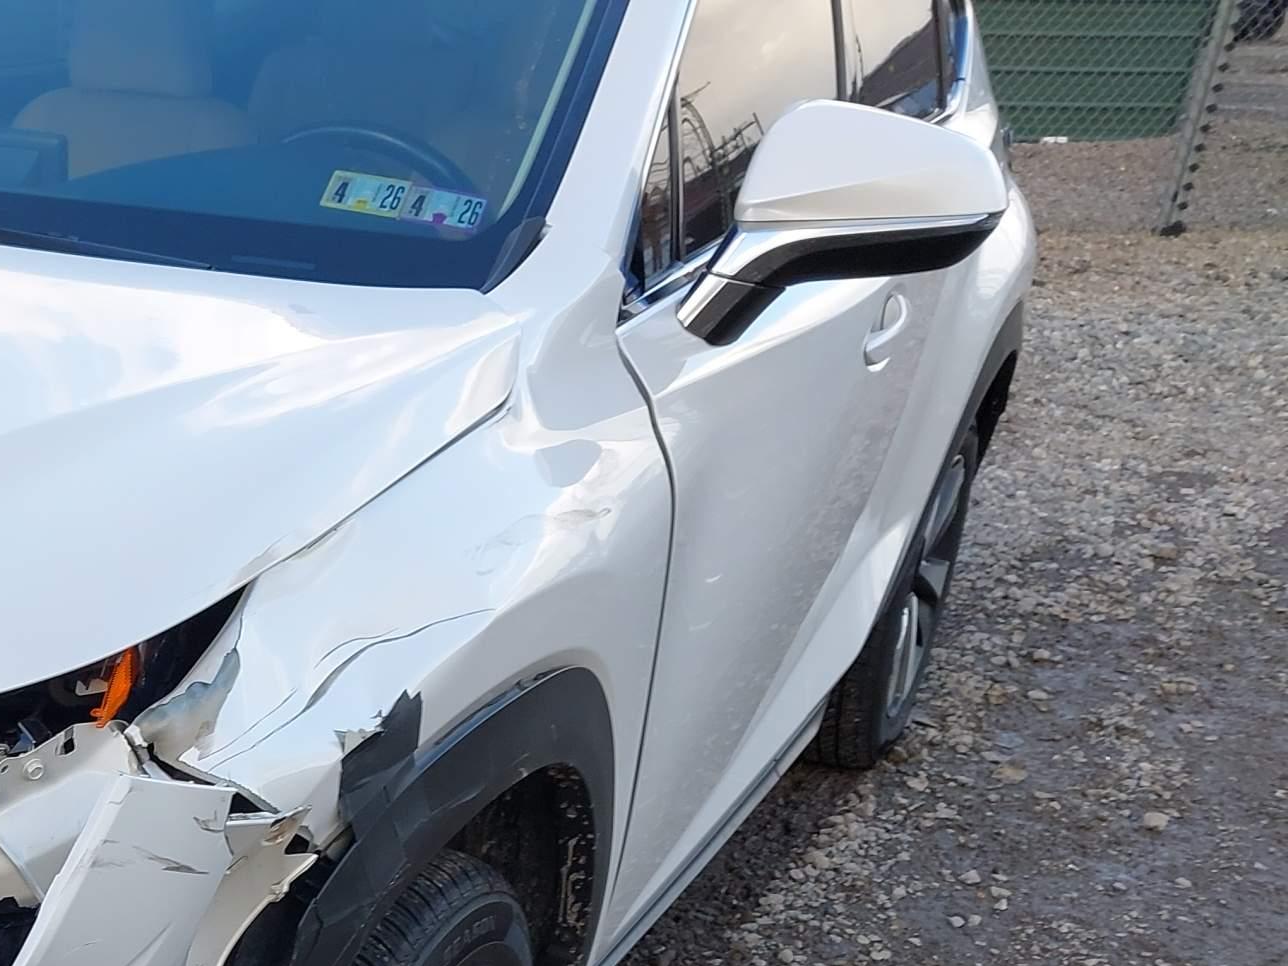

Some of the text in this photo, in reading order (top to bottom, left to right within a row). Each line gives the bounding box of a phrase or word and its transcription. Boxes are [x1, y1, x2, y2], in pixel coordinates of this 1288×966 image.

[333, 181, 406, 210] 4 26
[409, 195, 484, 225] 4 26
